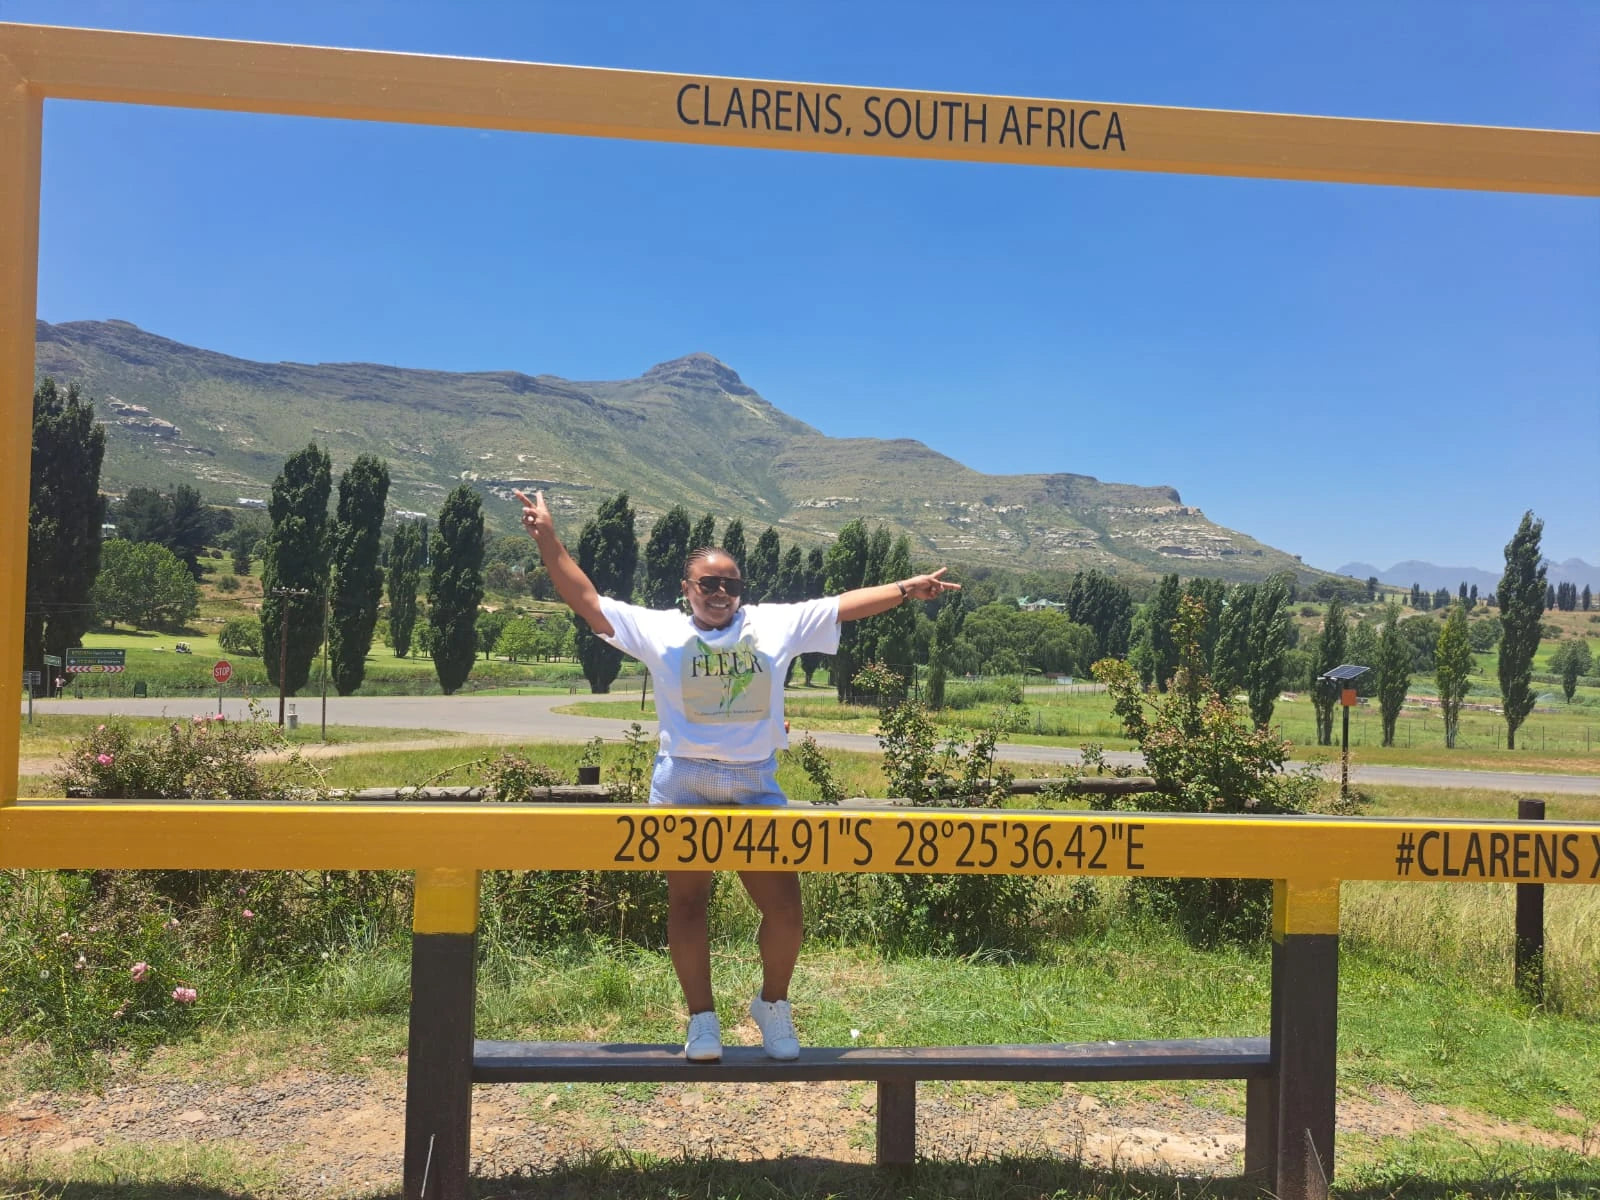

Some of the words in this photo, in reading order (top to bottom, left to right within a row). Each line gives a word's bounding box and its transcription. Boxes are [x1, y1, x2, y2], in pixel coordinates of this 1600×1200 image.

[677, 83, 852, 137] CLARENS,
[863, 95, 988, 144] SOUTH
[998, 104, 1127, 152] AFRICA
[214, 666, 230, 677] STOP
[690, 650, 764, 678] FLEUR
[1395, 830, 1580, 879] #CLARENS
